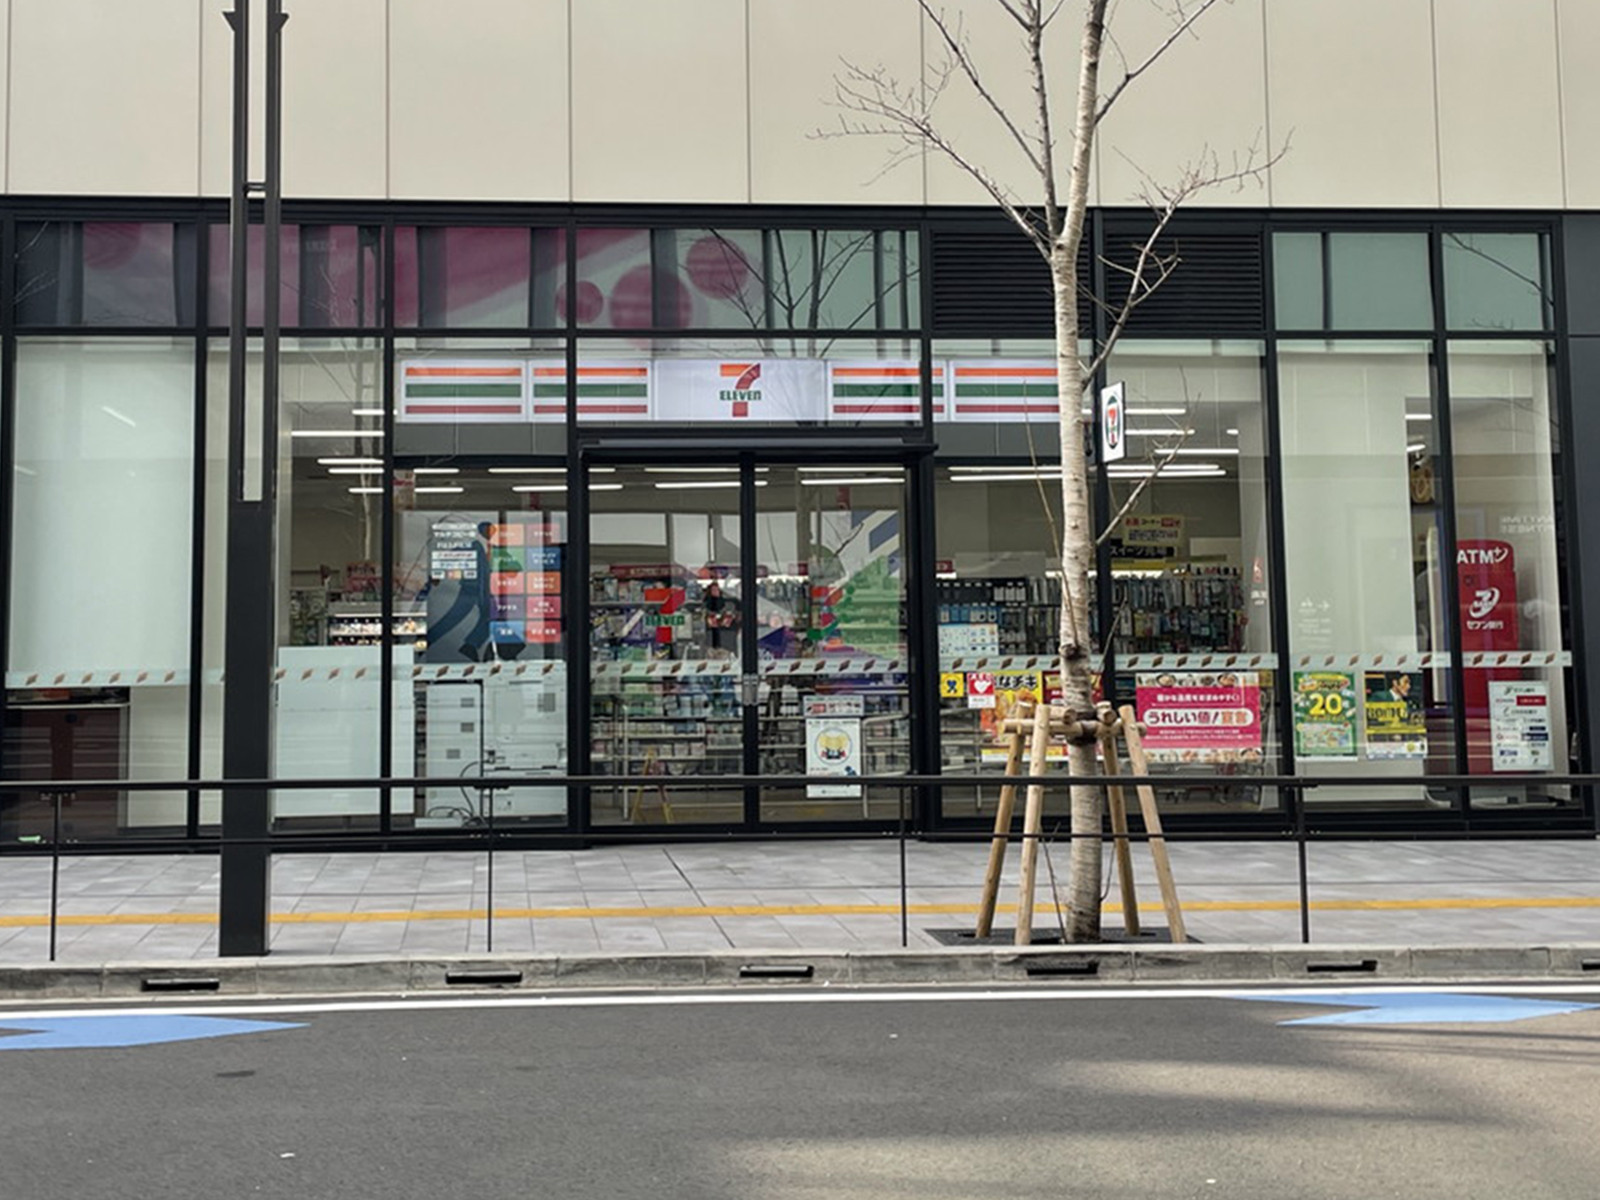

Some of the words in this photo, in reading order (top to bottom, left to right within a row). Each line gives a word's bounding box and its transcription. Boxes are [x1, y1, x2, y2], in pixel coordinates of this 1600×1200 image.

[720, 363, 761, 417] 7
[1457, 549, 1494, 564] ATM
[1309, 692, 1343, 715] 20
